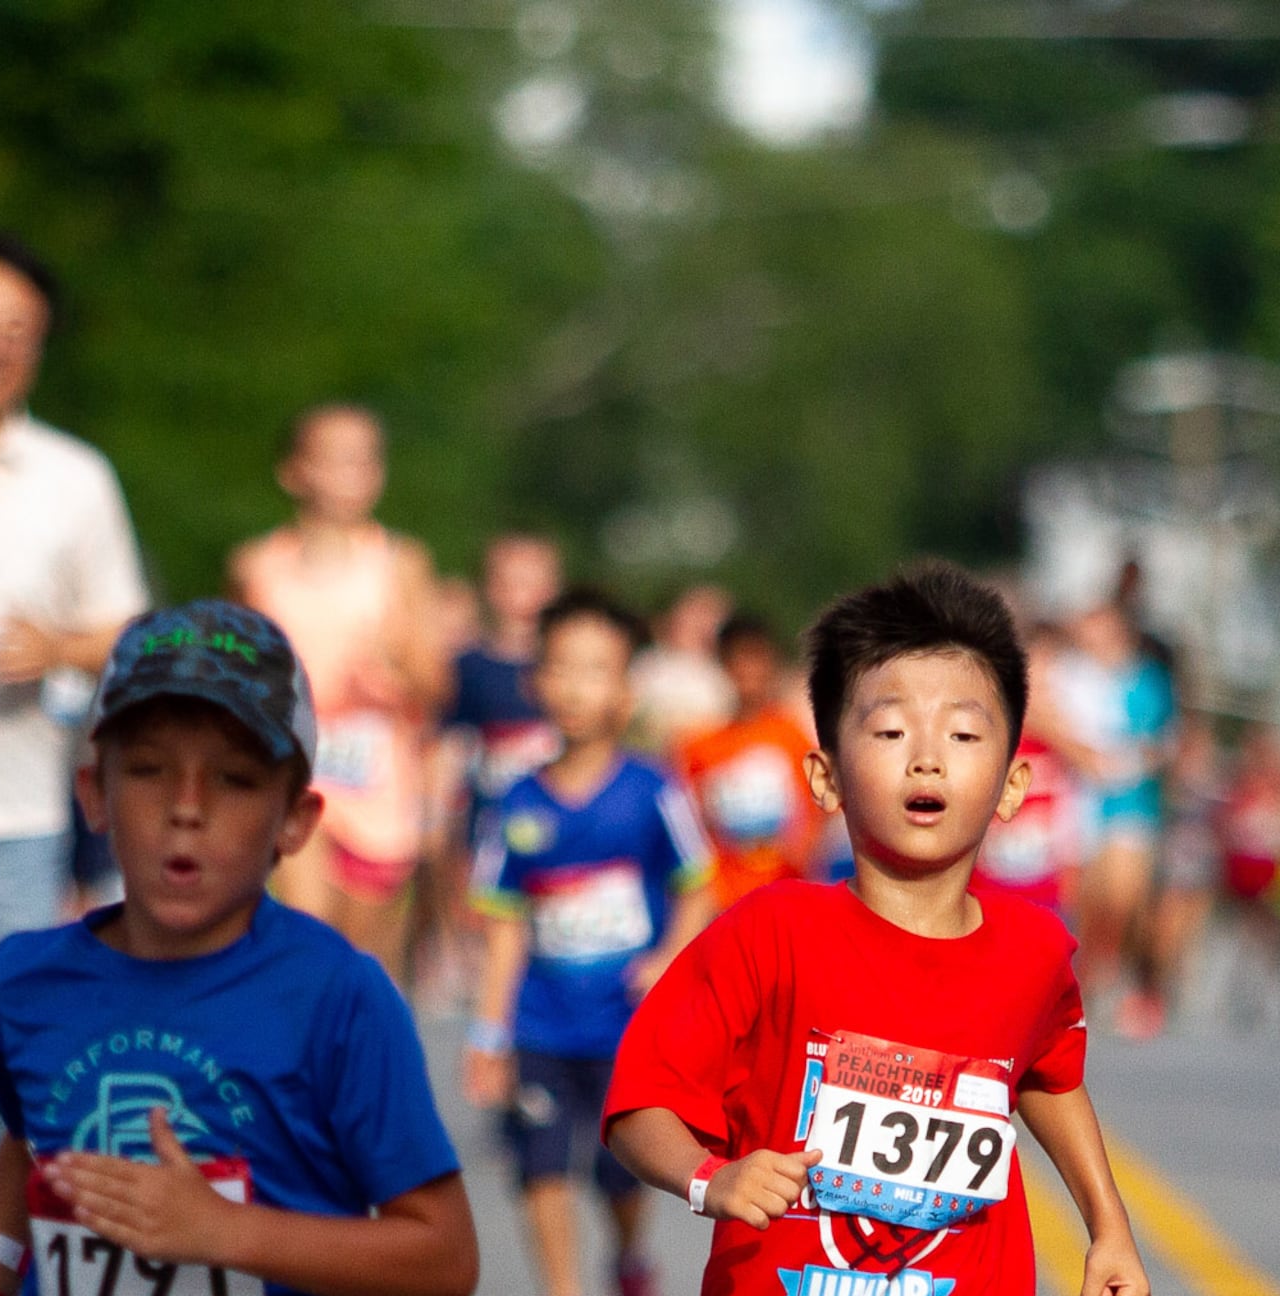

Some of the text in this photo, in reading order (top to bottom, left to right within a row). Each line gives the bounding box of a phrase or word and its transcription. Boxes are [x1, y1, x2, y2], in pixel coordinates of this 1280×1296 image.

[806, 1041, 827, 1057] BLU
[43, 1029, 254, 1127] PERFORMANCE
[832, 1071, 901, 1100] JUNIOR
[900, 1086, 943, 1107] 2019
[838, 1053, 946, 1089] PEACHTREE
[833, 1101, 1004, 1191] 1379
[893, 1187, 925, 1204] MILE
